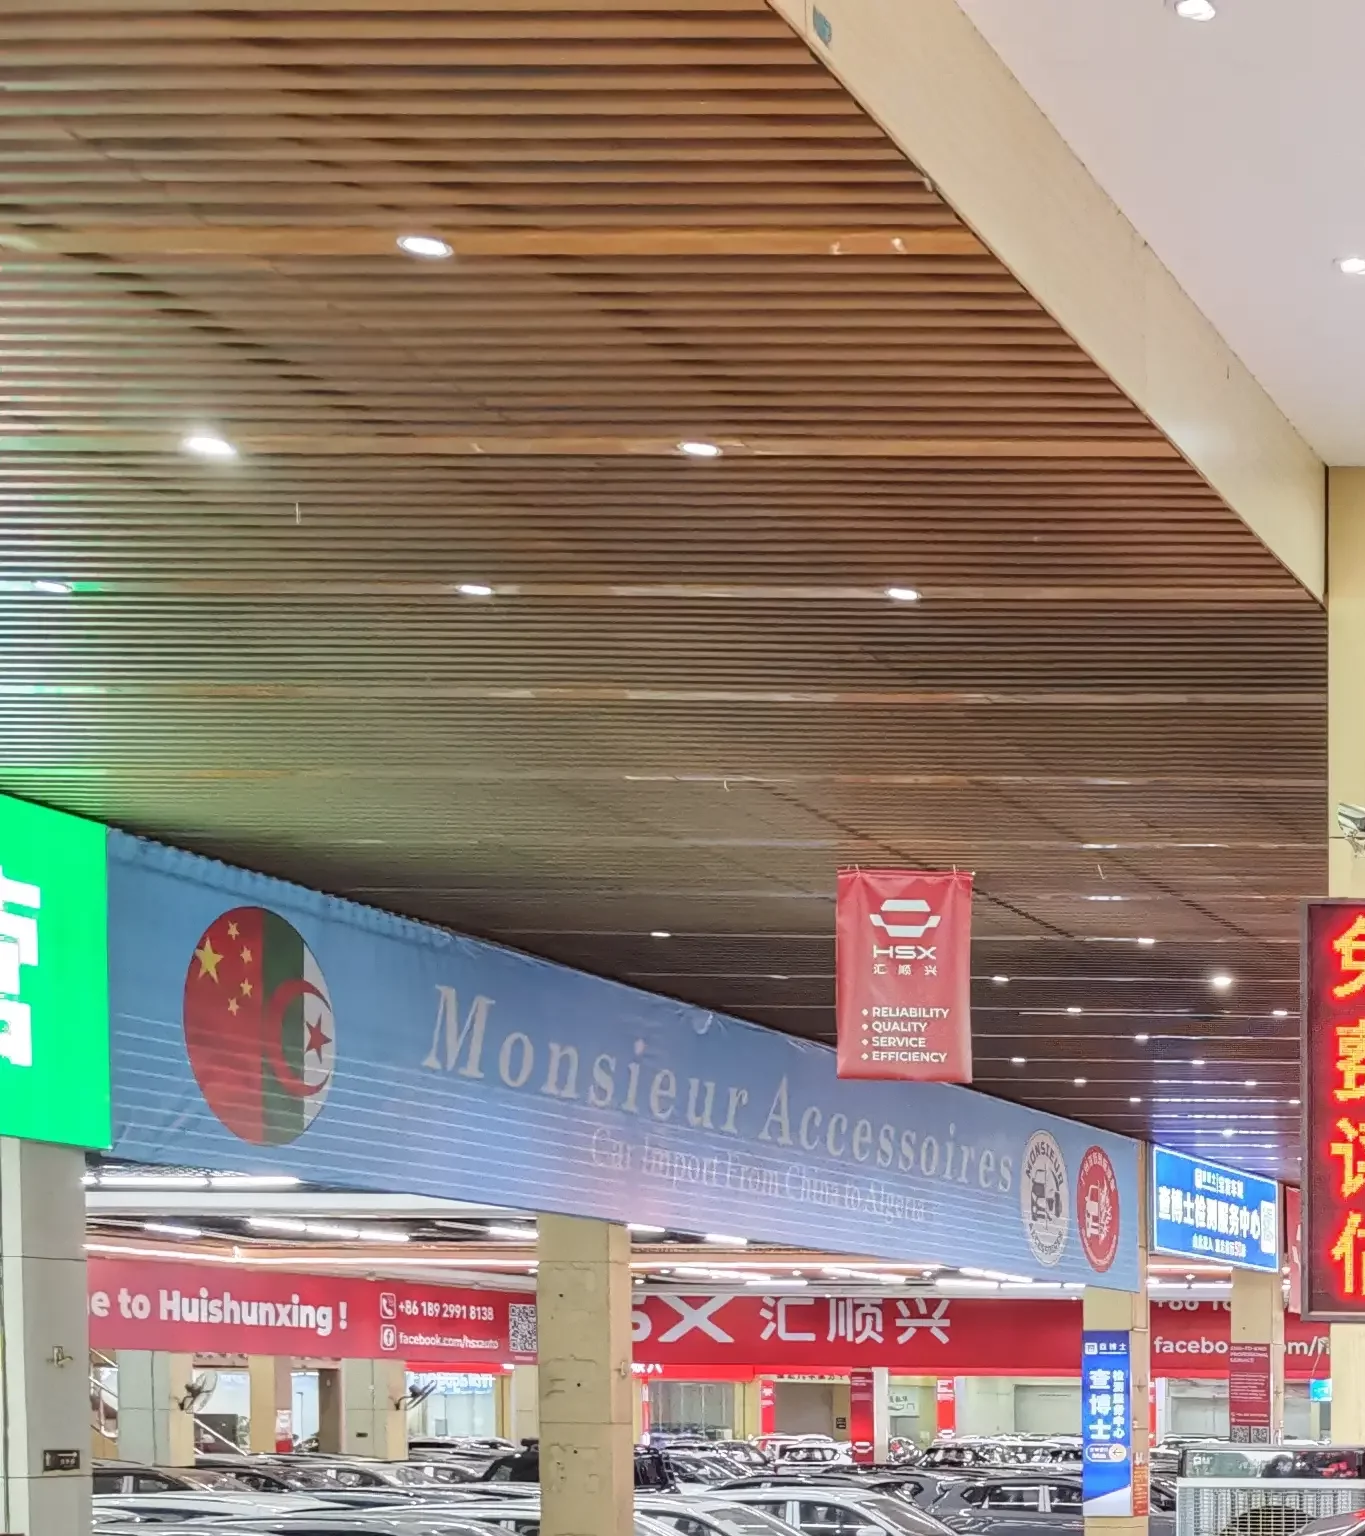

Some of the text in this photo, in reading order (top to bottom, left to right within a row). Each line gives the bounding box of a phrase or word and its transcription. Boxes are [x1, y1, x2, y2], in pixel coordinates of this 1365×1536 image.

[873, 944, 937, 960] HSX
[873, 963, 938, 977] 汇顺兴
[872, 1006, 950, 1019] RELIABILITY
[872, 1021, 928, 1034] QUALITY
[872, 1036, 927, 1048] SERVICE
[872, 1050, 948, 1063] EFFICIENCY
[420, 983, 1013, 1193] Monsieur Accessoires
[1026, 1141, 1064, 1187] MONSIEUR
[88, 1290, 109, 1317] e
[117, 1286, 149, 1320] to
[158, 1286, 333, 1337] Huishunxing
[399, 1299, 494, 1321] +86 189 2991 8138
[759, 1296, 951, 1344] 汇顺兴
[1089, 1368, 1112, 1441] 查博士
